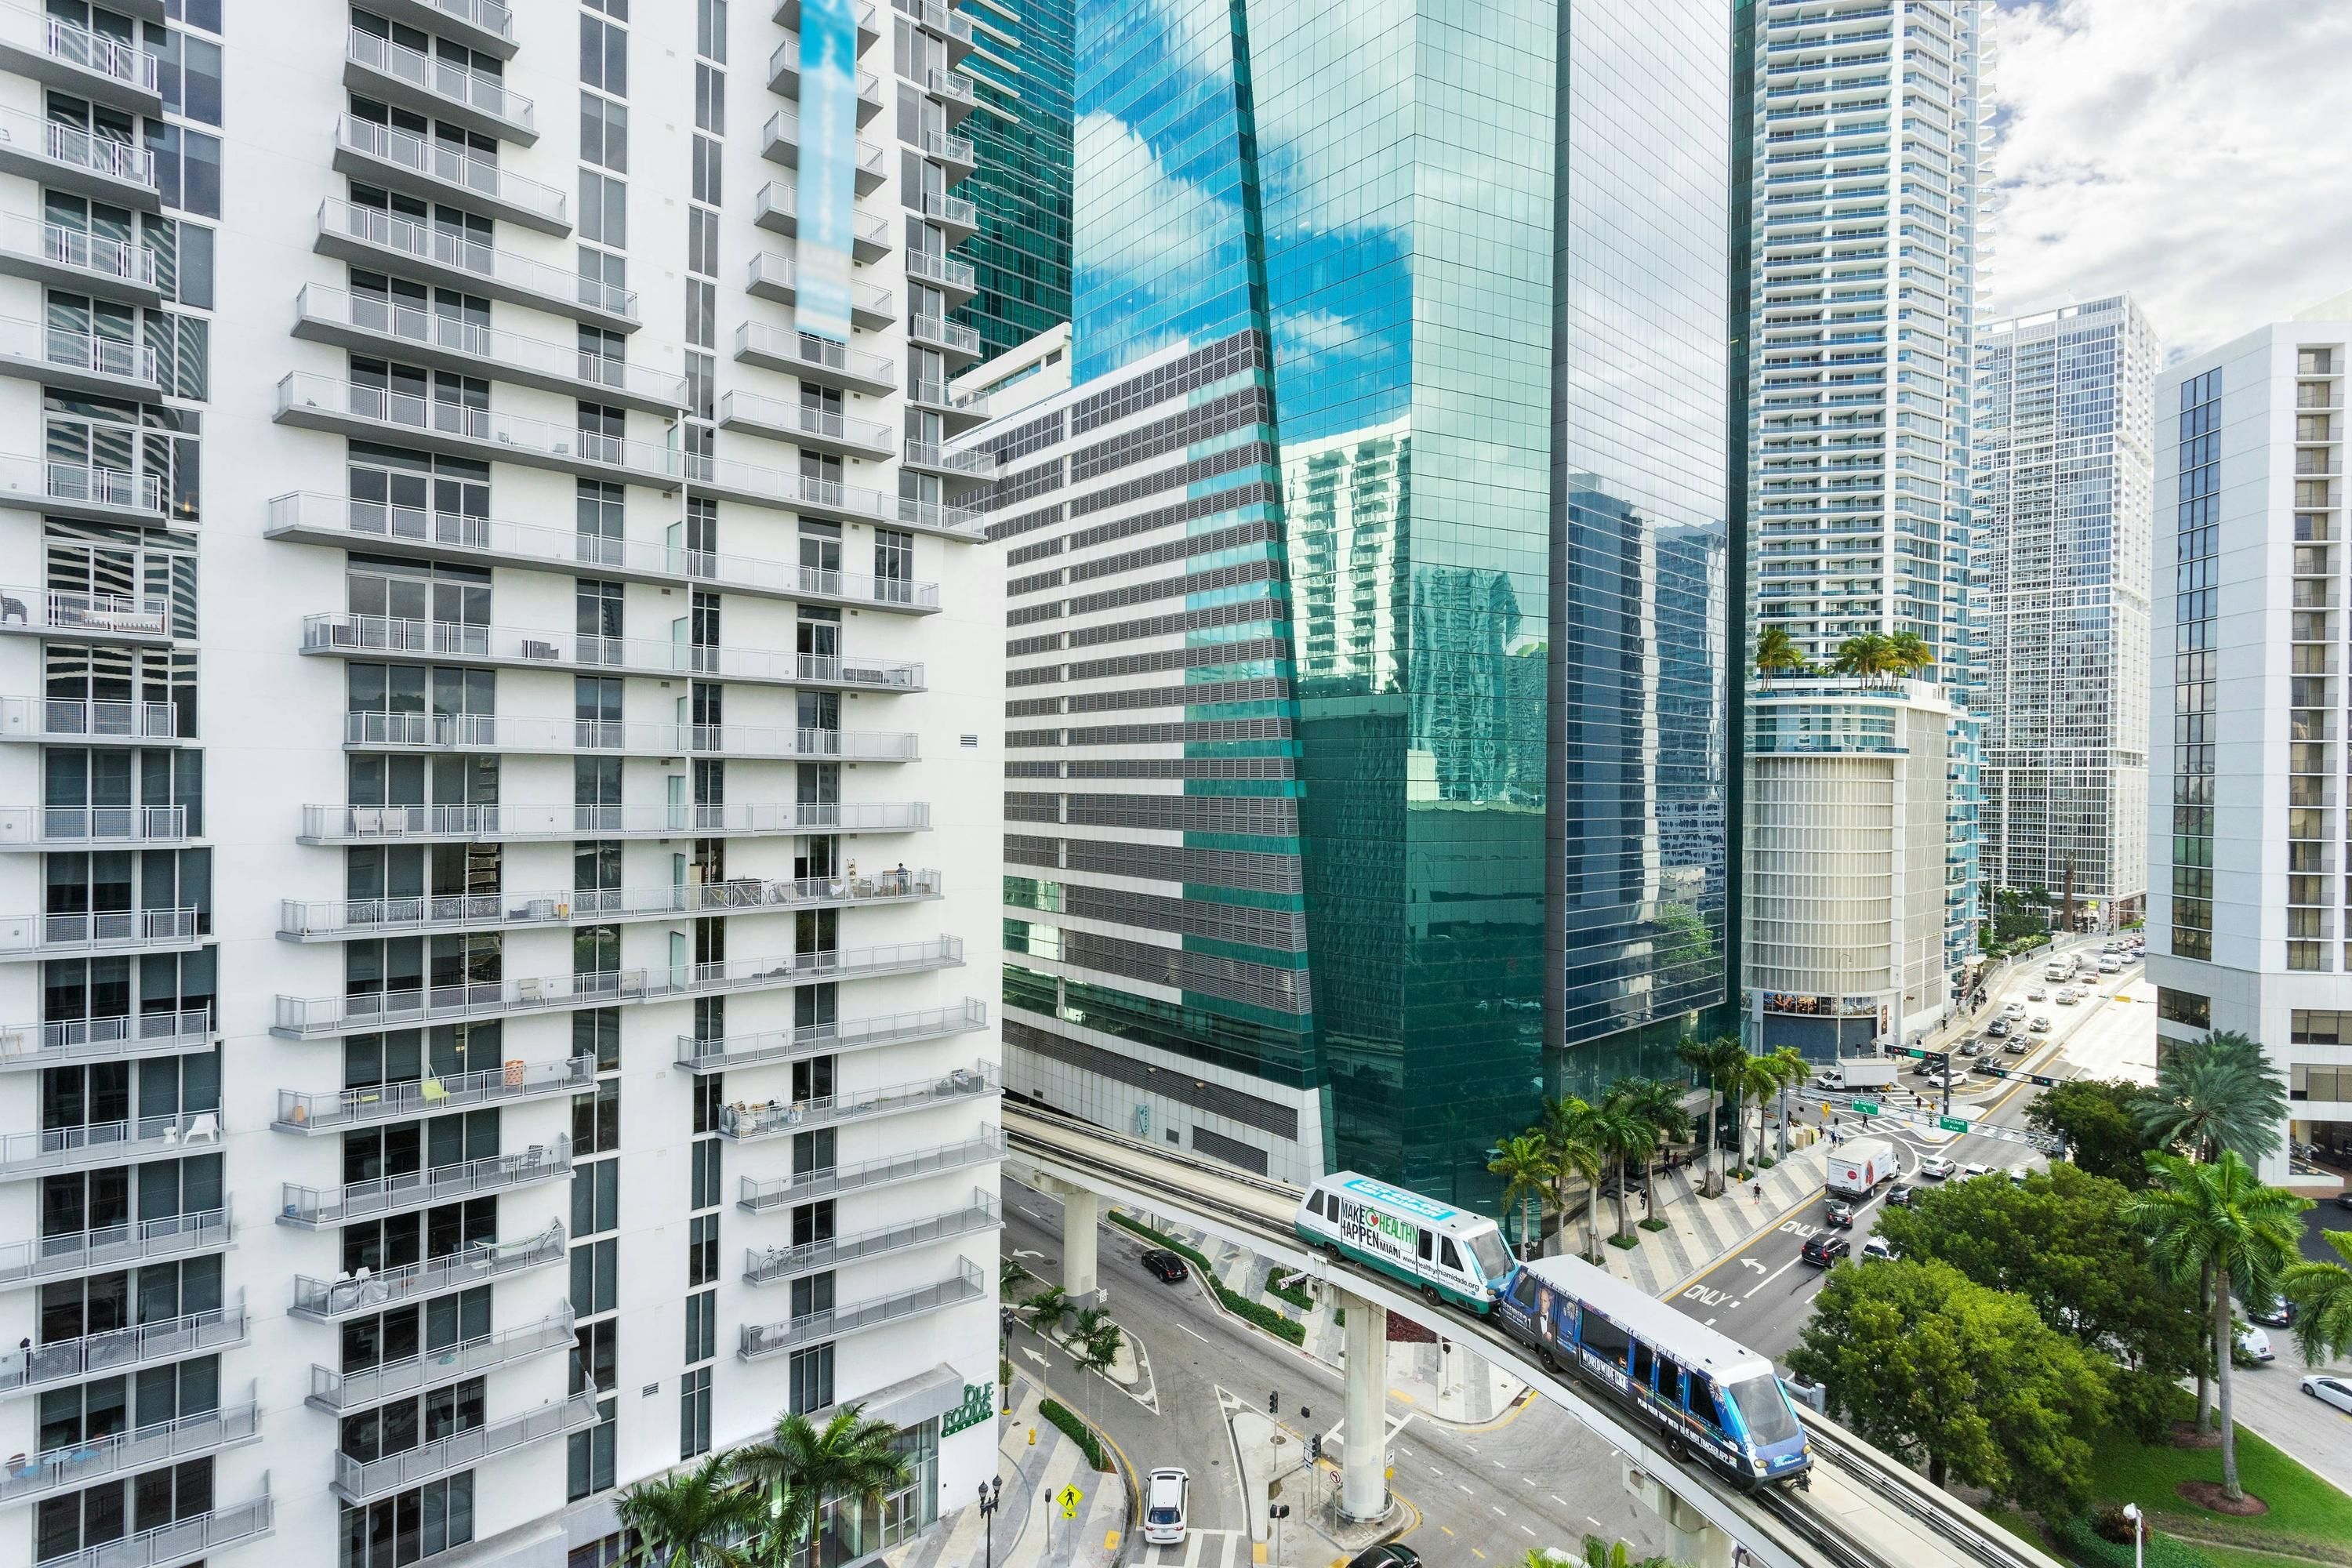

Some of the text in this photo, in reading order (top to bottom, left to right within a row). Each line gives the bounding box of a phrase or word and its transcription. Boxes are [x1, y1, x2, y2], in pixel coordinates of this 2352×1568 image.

[1944, 1117, 1965, 1127] Brickell
[1350, 1183, 1440, 1218] ADVERTISE HERE
[1341, 1201, 1366, 1225] MAKE
[1341, 1220, 1379, 1250] HAPPEN
[1380, 1242, 1401, 1259] MIAMI
[1778, 1220, 1824, 1240] ONLY
[1403, 1255, 1479, 1292] wwwhealthymiamidade.org
[1682, 1284, 1733, 1307] ONLY
[1523, 1315, 1531, 1330] 31
[1582, 1350, 1615, 1381] WORLDWIDE
[964, 1381, 994, 1405] OLE
[943, 1396, 992, 1430] FOODS
[946, 1413, 990, 1436] MARKET
[1637, 1396, 1648, 1410] PLAN
[1647, 1403, 1658, 1417] YOUR
[1658, 1410, 1668, 1423] TRIP
[1668, 1417, 1679, 1431] WITH
[1679, 1425, 1690, 1437] THE
[1700, 1438, 1719, 1457] TRACKER
[1719, 1450, 1728, 1461] APP
